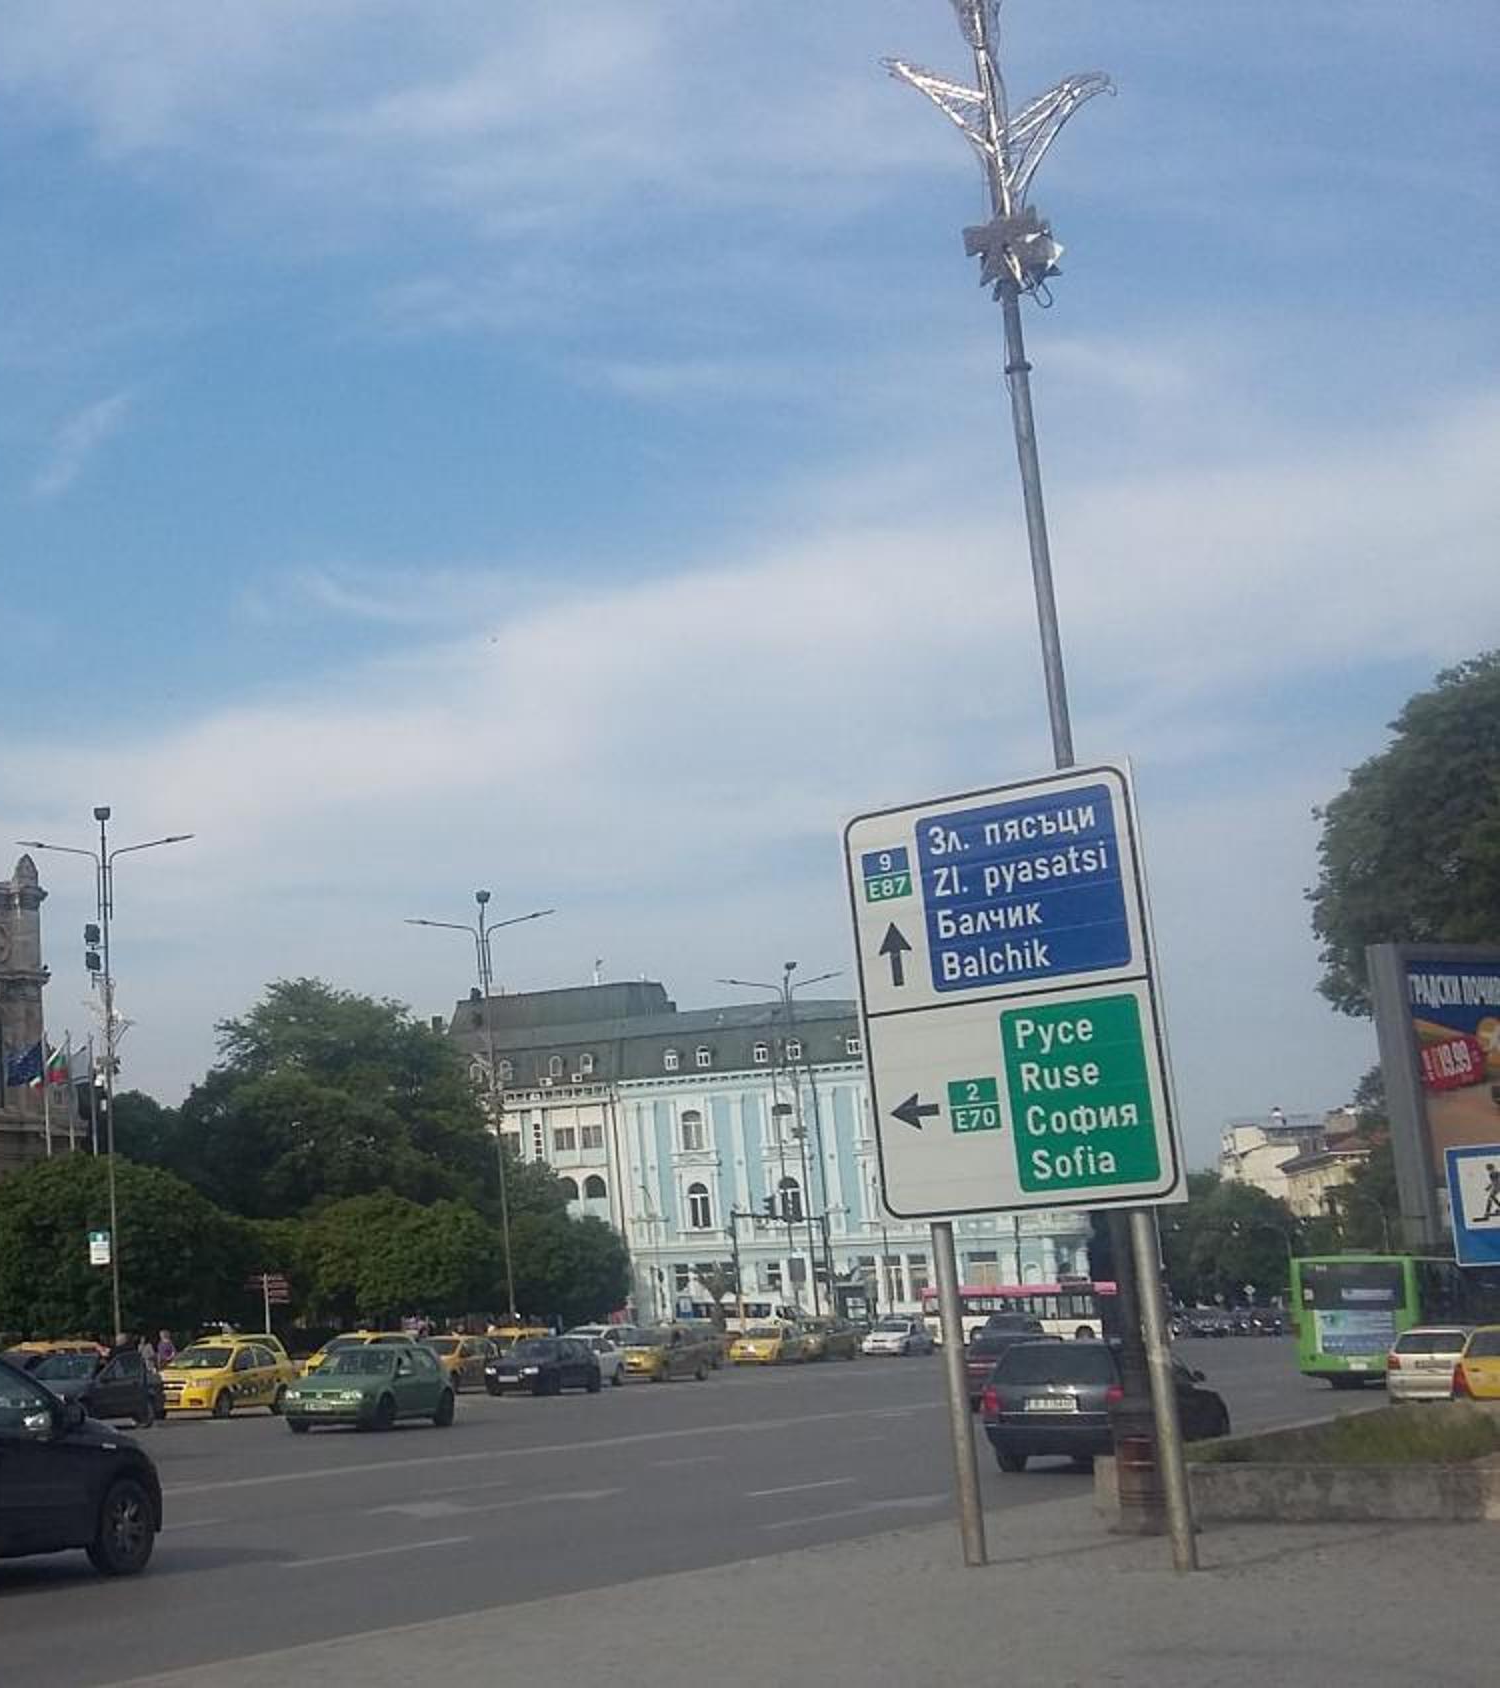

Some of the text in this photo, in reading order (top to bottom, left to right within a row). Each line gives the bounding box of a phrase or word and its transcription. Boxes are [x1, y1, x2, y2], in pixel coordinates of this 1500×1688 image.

[928, 805, 1096, 855] Зл. пясъци
[879, 853, 891, 871] 9
[933, 841, 1108, 897] Zl. pyasatsi
[869, 876, 907, 899] E87
[937, 901, 1043, 939] Балчик
[942, 938, 1050, 981] Balchik
[1015, 1018, 1093, 1054] Русе
[966, 1083, 980, 1101] 2
[1020, 1062, 1100, 1093] Ruse
[956, 1108, 996, 1129] E70
[1027, 1103, 1138, 1136] София
[1032, 1145, 1117, 1180] Sofia
